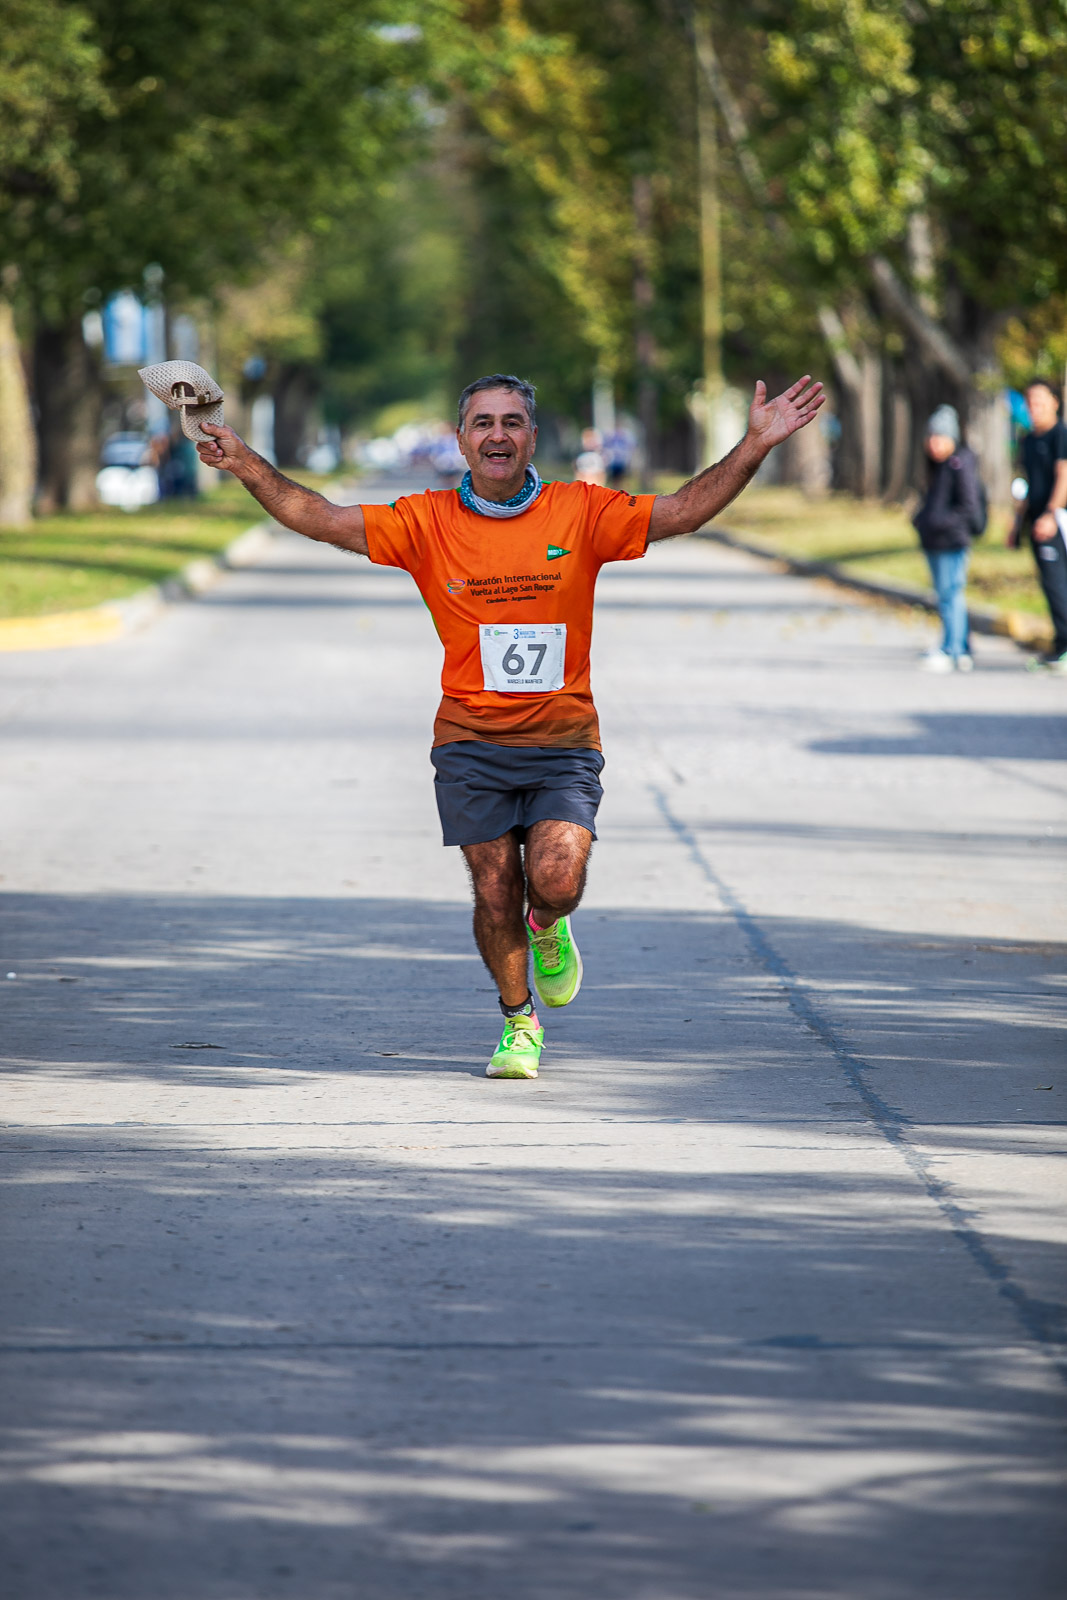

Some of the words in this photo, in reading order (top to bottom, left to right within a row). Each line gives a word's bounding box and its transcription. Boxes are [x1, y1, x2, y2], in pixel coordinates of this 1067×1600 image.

[466, 576, 502, 587] Maratón
[504, 572, 562, 583] Internacional
[470, 588, 492, 596] Vuelta
[493, 587, 500, 595] al
[501, 586, 518, 595] Lago
[520, 584, 533, 592] San
[534, 583, 555, 593] Roque
[513, 628, 519, 640] 3
[502, 643, 548, 676] 67
